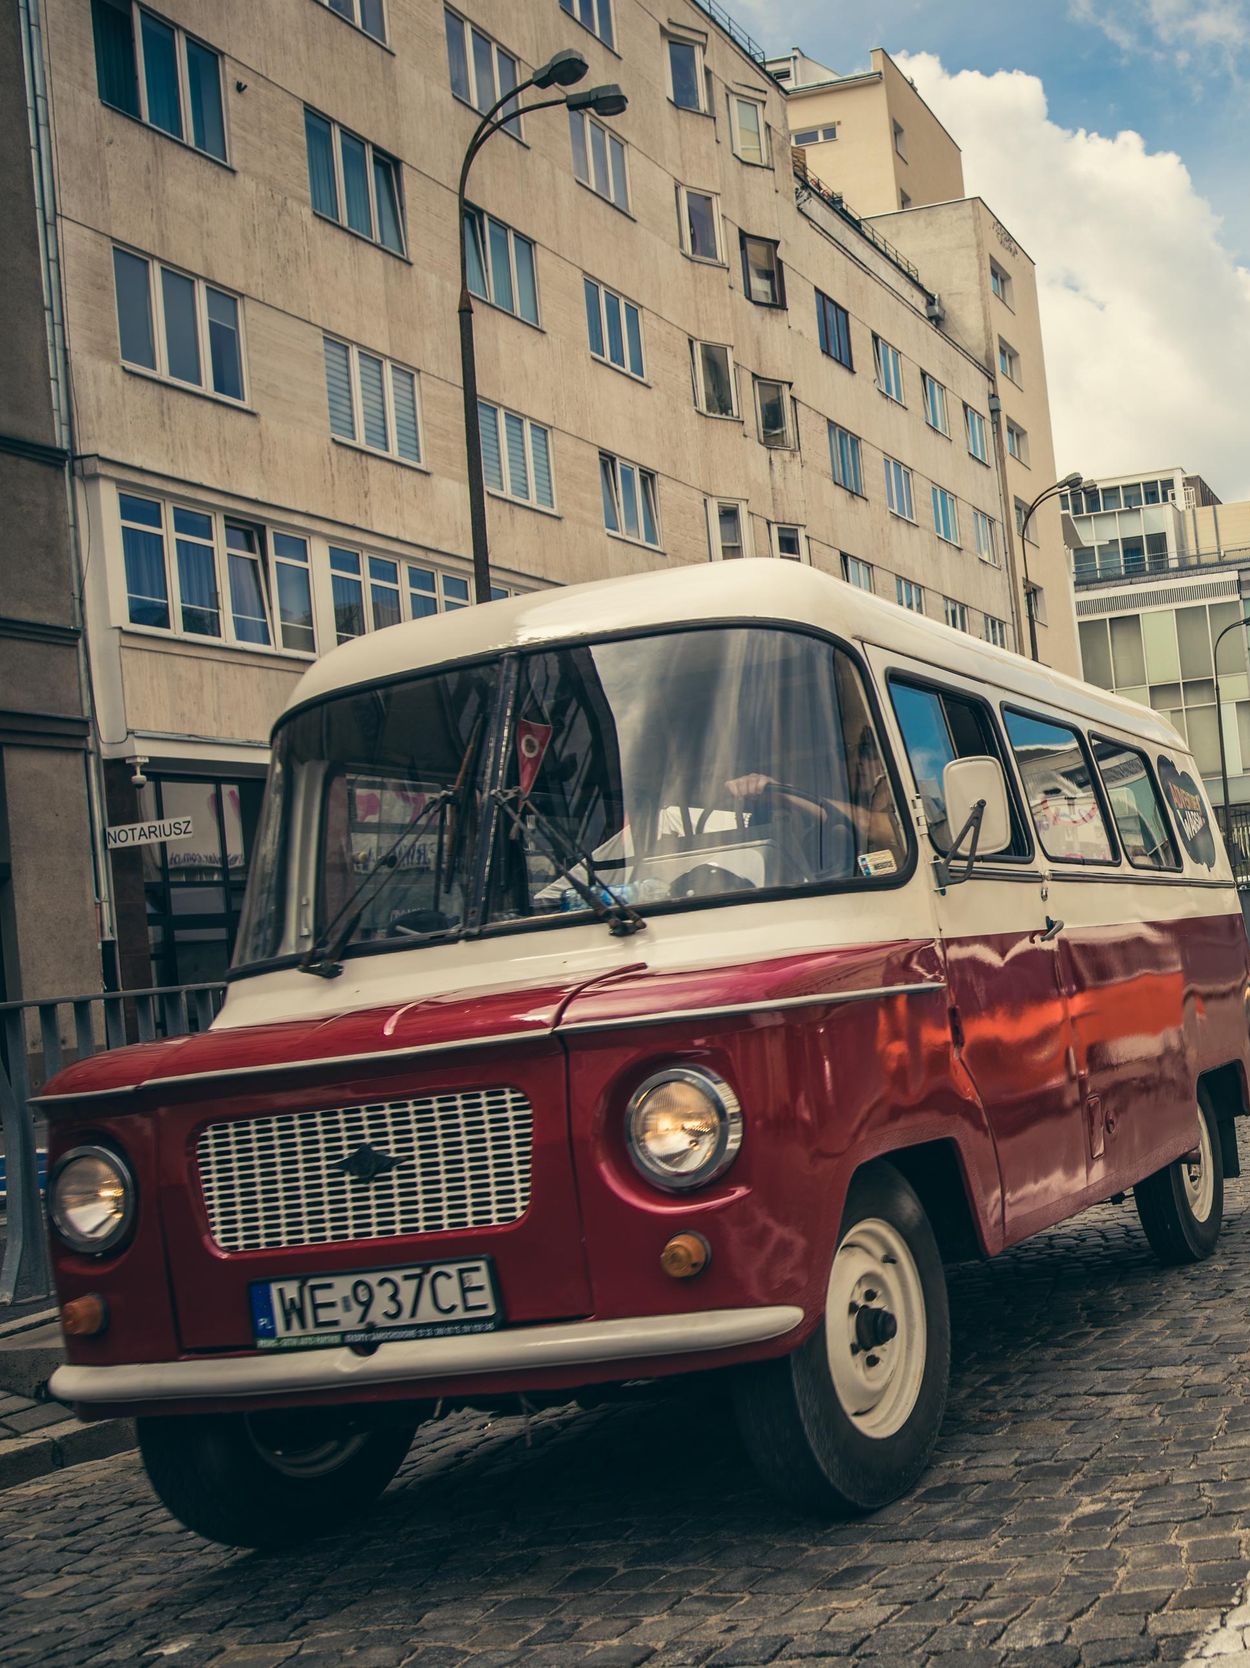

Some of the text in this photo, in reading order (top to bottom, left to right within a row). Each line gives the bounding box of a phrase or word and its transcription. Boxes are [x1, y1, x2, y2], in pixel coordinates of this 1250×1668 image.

[107, 820, 193, 845] NOTARIUSZ
[258, 1265, 489, 1332] PL WE 937CE
